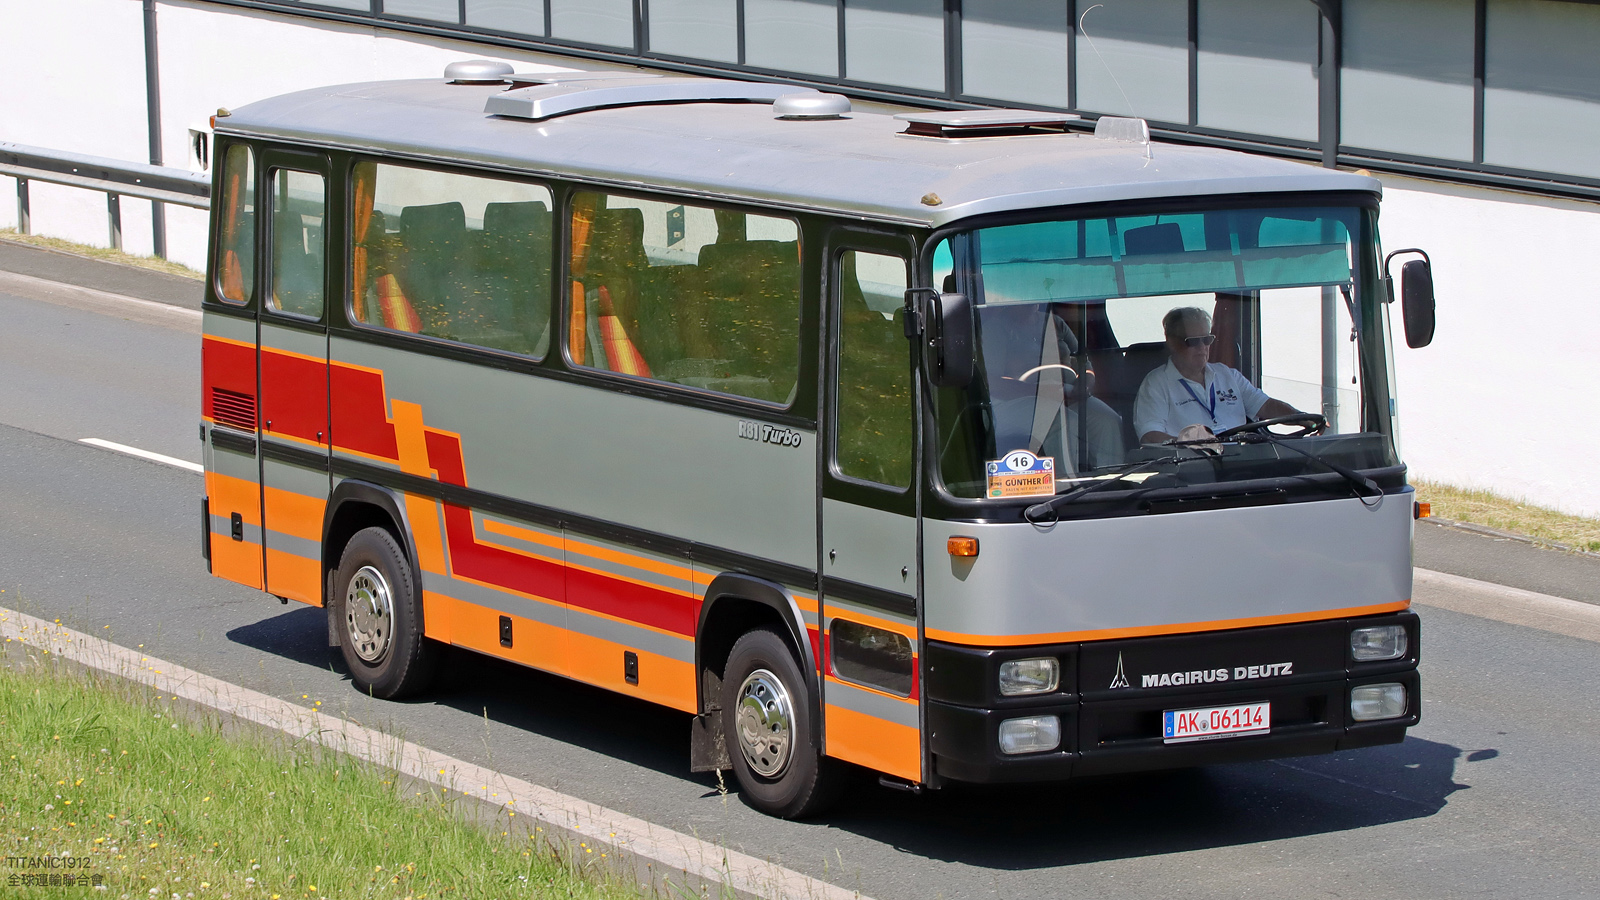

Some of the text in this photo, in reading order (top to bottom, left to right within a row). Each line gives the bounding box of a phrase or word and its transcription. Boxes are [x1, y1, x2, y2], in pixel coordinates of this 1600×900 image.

[738, 420, 801, 448] R81 Turbo
[1012, 456, 1028, 468] 16
[1005, 477, 1042, 487] GÜNTHER
[1142, 662, 1293, 688] MAGIRUS DEUTZ
[1177, 705, 1263, 733] AK 06114
